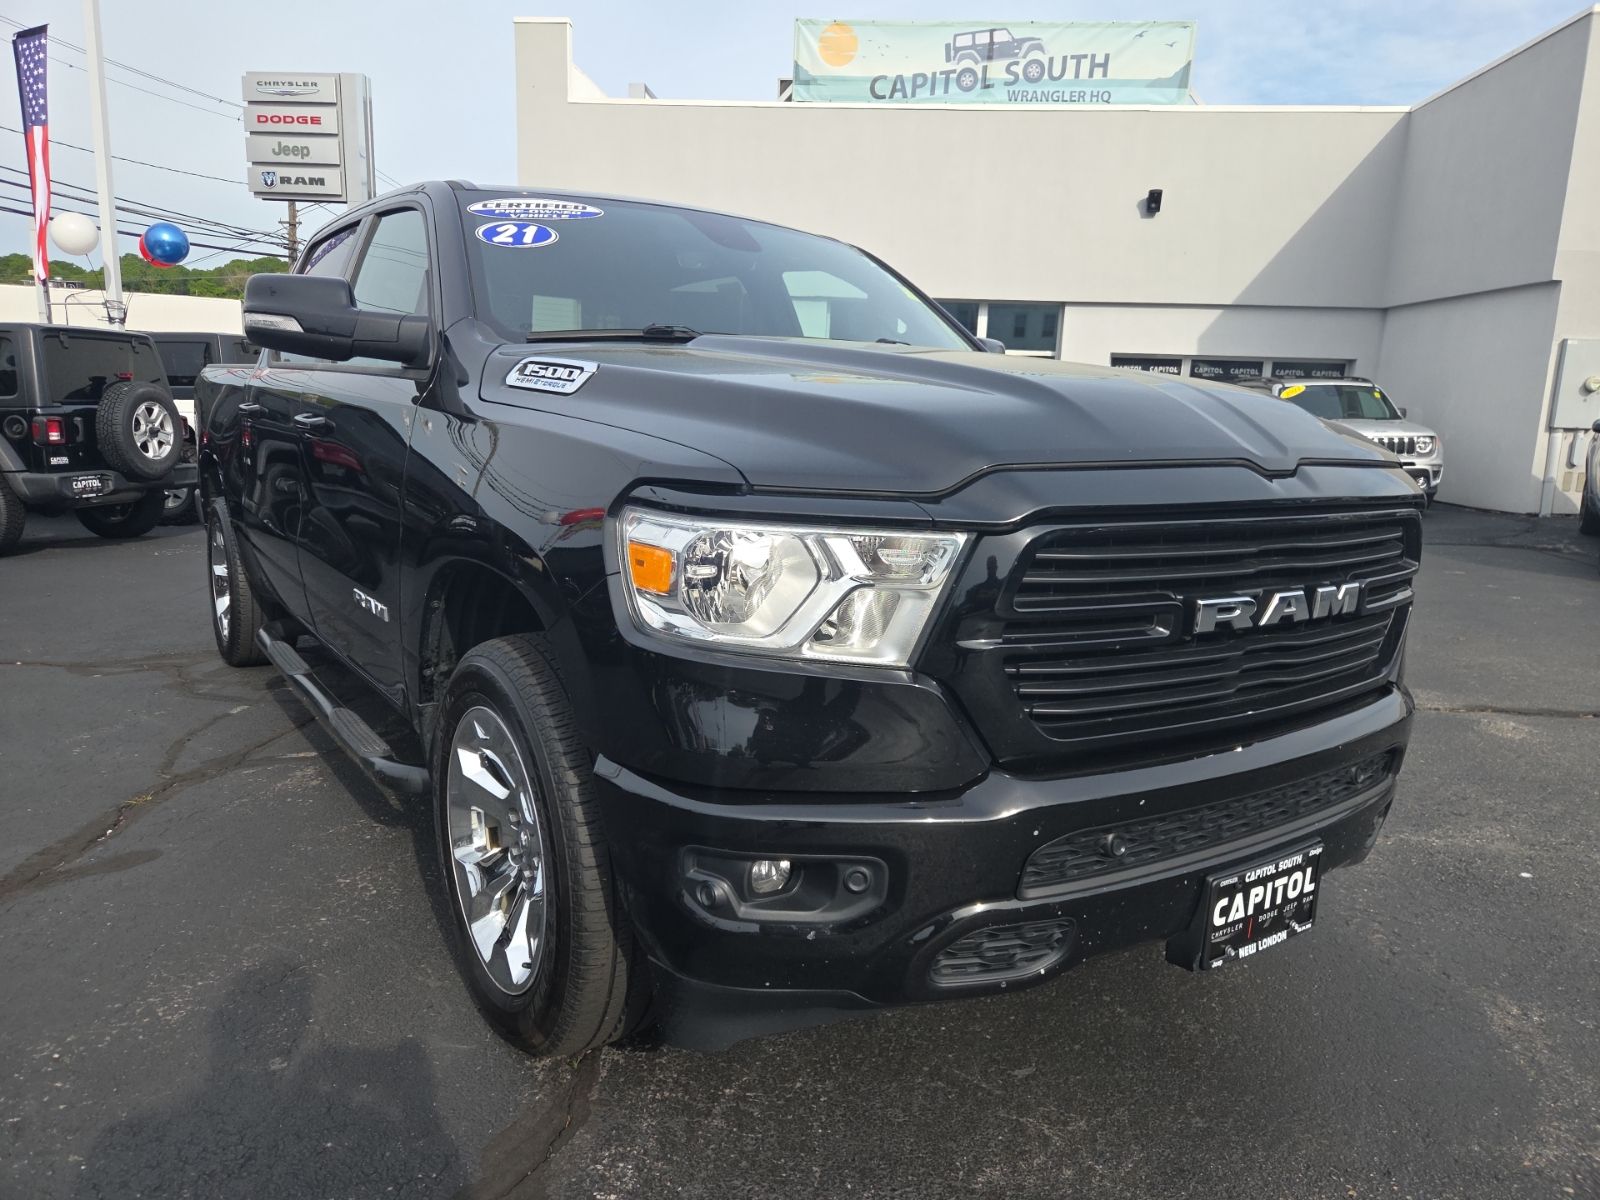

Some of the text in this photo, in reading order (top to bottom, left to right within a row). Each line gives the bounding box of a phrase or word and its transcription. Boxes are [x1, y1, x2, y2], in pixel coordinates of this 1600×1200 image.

[256, 80, 318, 88] CHRYSLER
[869, 53, 1110, 100] CAPITOL SOUTH
[1007, 89, 1112, 104] WRANGLER HQ
[256, 114, 322, 125] DODGE
[271, 141, 310, 159] Jeep
[280, 176, 325, 186] RAM
[481, 202, 588, 211] CERTIFIED
[492, 224, 538, 243] 21
[524, 364, 580, 380] 1500
[1230, 368, 1260, 376] CAPITOL
[1275, 369, 1305, 377] CAPITOL
[515, 377, 534, 385] HEMI
[73, 480, 101, 489] CAPITOL
[1193, 582, 1360, 634] RAM
[1245, 854, 1303, 883] CAPITOL SOUTH
[1213, 867, 1315, 927] CAPITOL
[1210, 895, 1313, 940] CHRYSLER DODGE JEEP RAM
[1238, 929, 1288, 959] NEW LONDON
